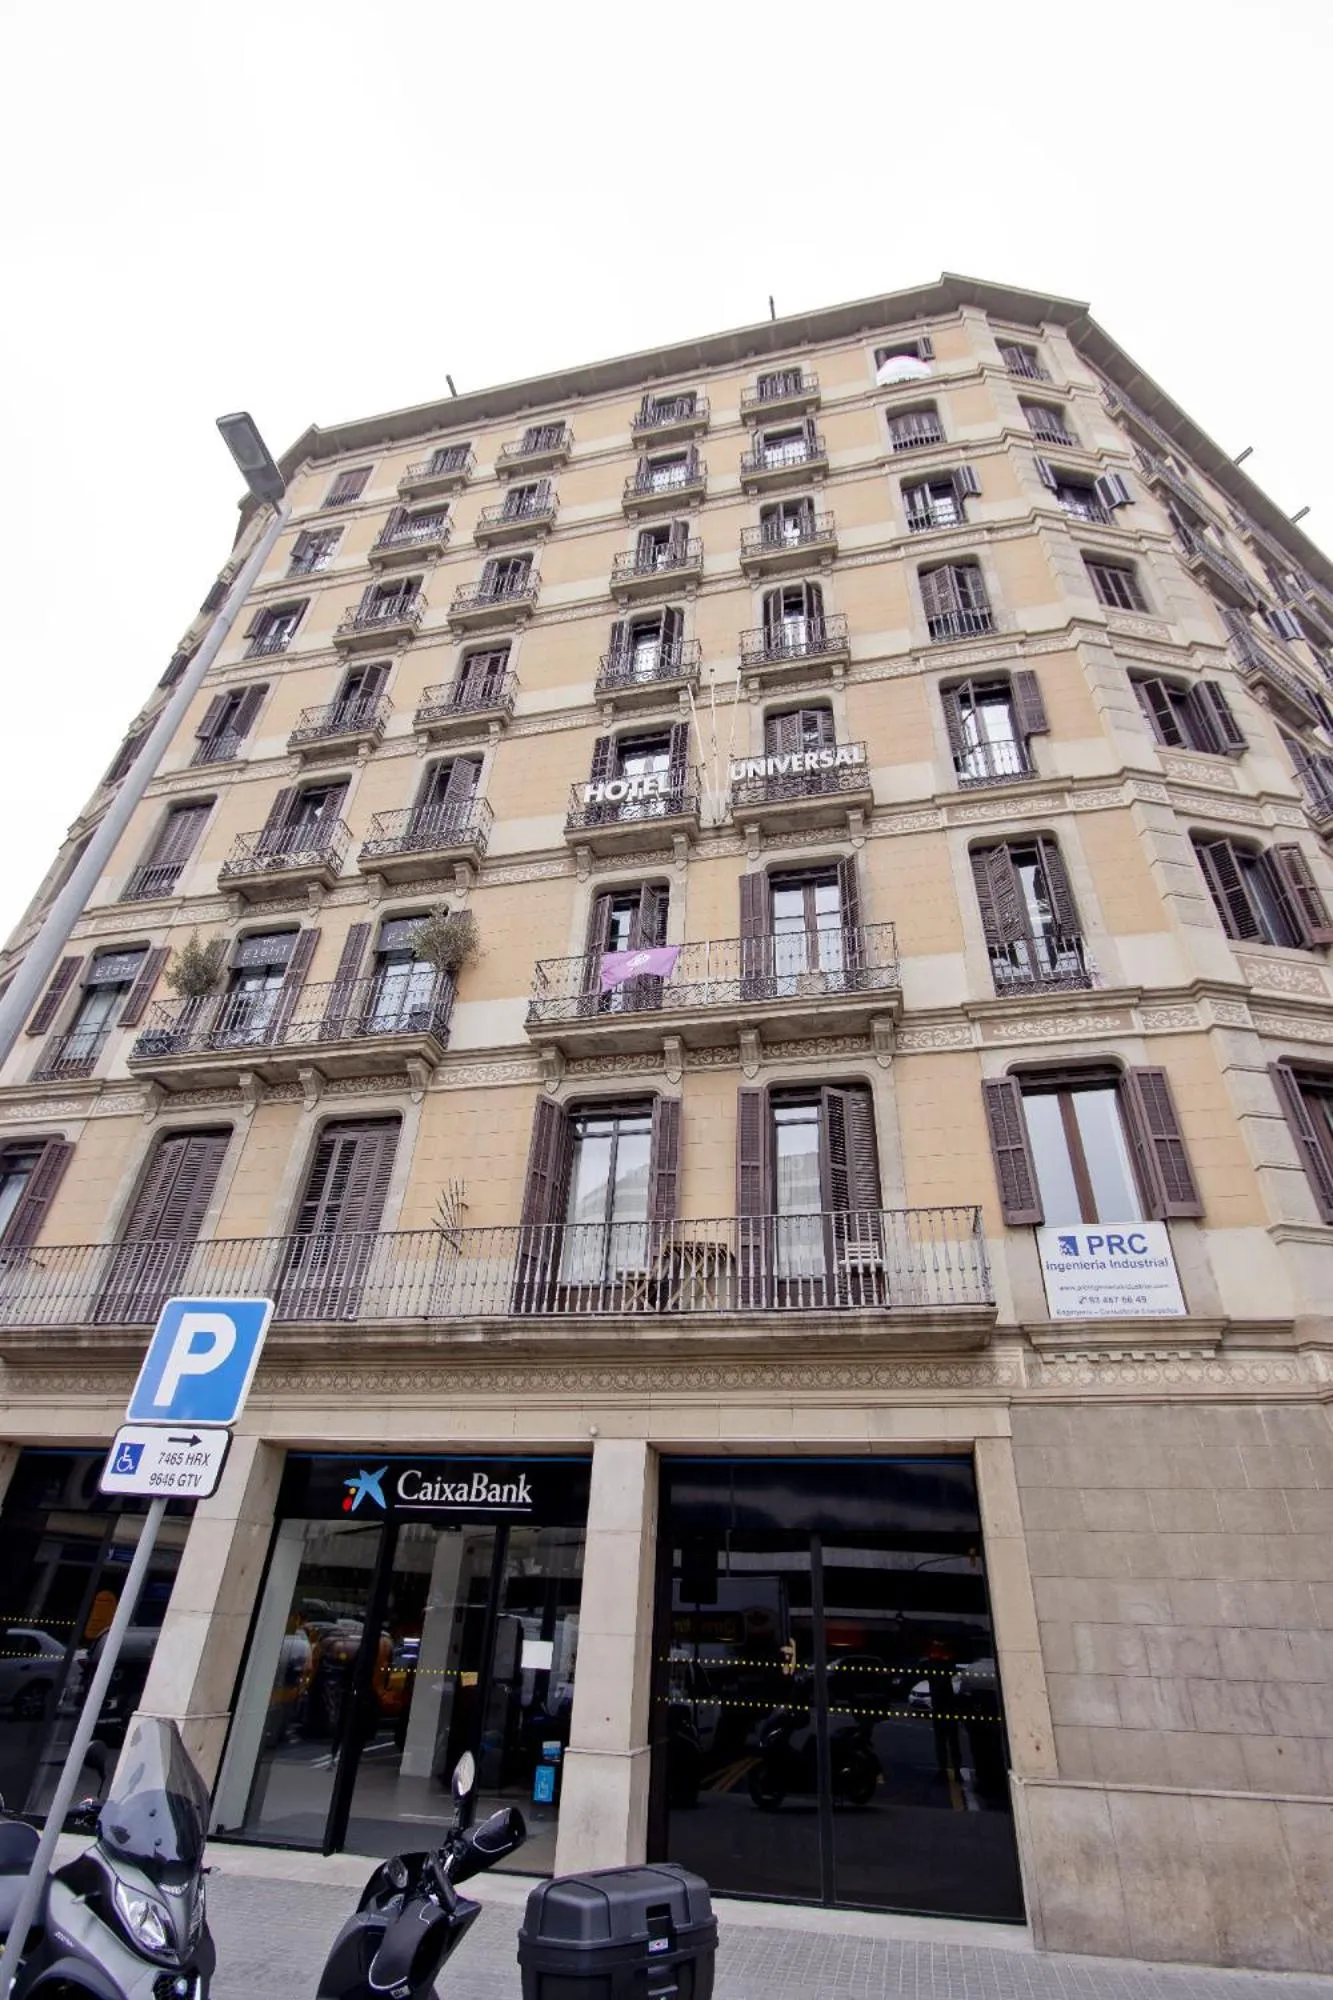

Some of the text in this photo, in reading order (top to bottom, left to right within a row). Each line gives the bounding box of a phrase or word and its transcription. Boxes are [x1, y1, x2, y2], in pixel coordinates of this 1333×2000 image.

[584, 747, 865, 804] HOTEL UNIVERSAL
[1086, 1234, 1148, 1255] PRC
[1110, 1258, 1168, 1269] Industrial
[153, 1313, 236, 1406] P
[158, 1452, 211, 1466] 7465 HRX
[178, 1473, 202, 1487] GTV
[397, 1470, 533, 1504] CaixaBank
